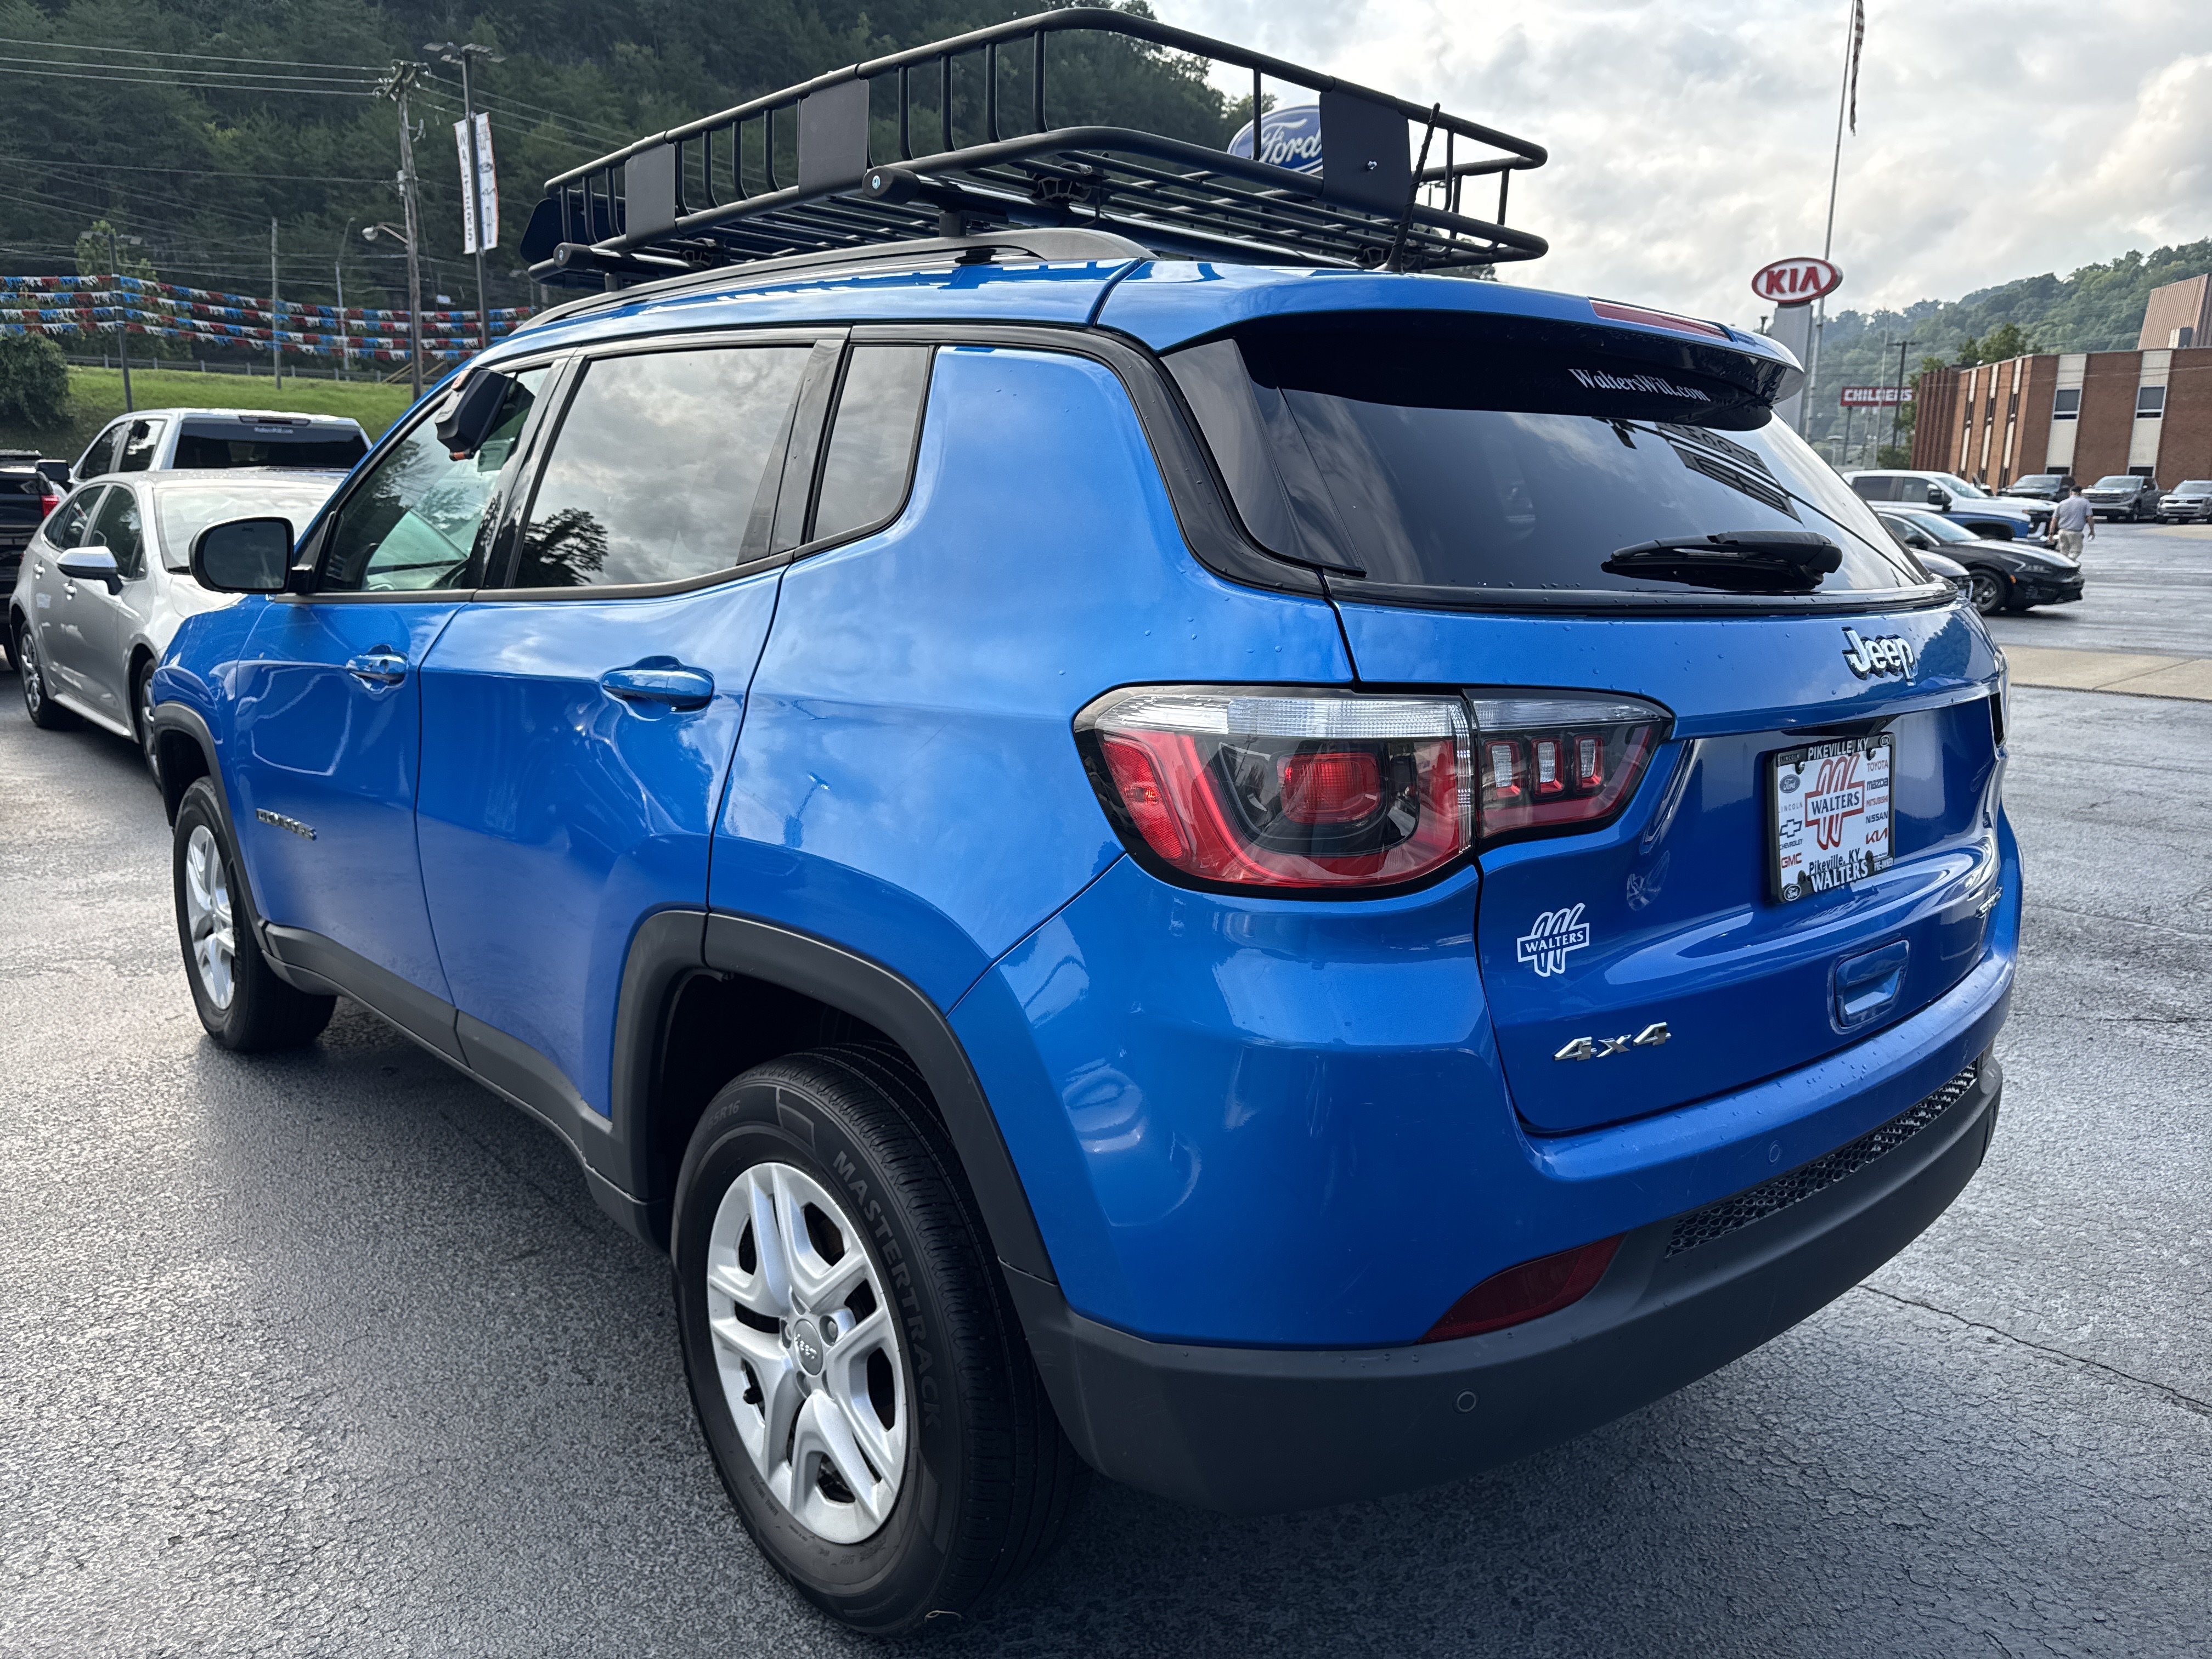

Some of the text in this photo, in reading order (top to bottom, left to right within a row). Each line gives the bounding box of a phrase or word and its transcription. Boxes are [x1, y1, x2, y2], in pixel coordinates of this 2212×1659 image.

[1251, 118, 1322, 165] Ford
[1765, 266, 1821, 295] KIA
[1567, 369, 1711, 402] WaltersWill.com
[1842, 627, 1916, 681] Jeep
[1808, 737, 1869, 761] PIKEVILLE, KY
[1867, 759, 1888, 772] TOYOTA
[1779, 800, 1803, 813] INCOLN
[1812, 791, 1860, 815] WALTERS
[1866, 811, 1888, 823] NISSAN
[1781, 852, 1802, 868] GMC
[1848, 848, 1860, 864] KY
[1811, 859, 1868, 893] WALTERS
[1525, 930, 1584, 953] WALTERS
[833, 1150, 940, 1427] MASTERTRACK
